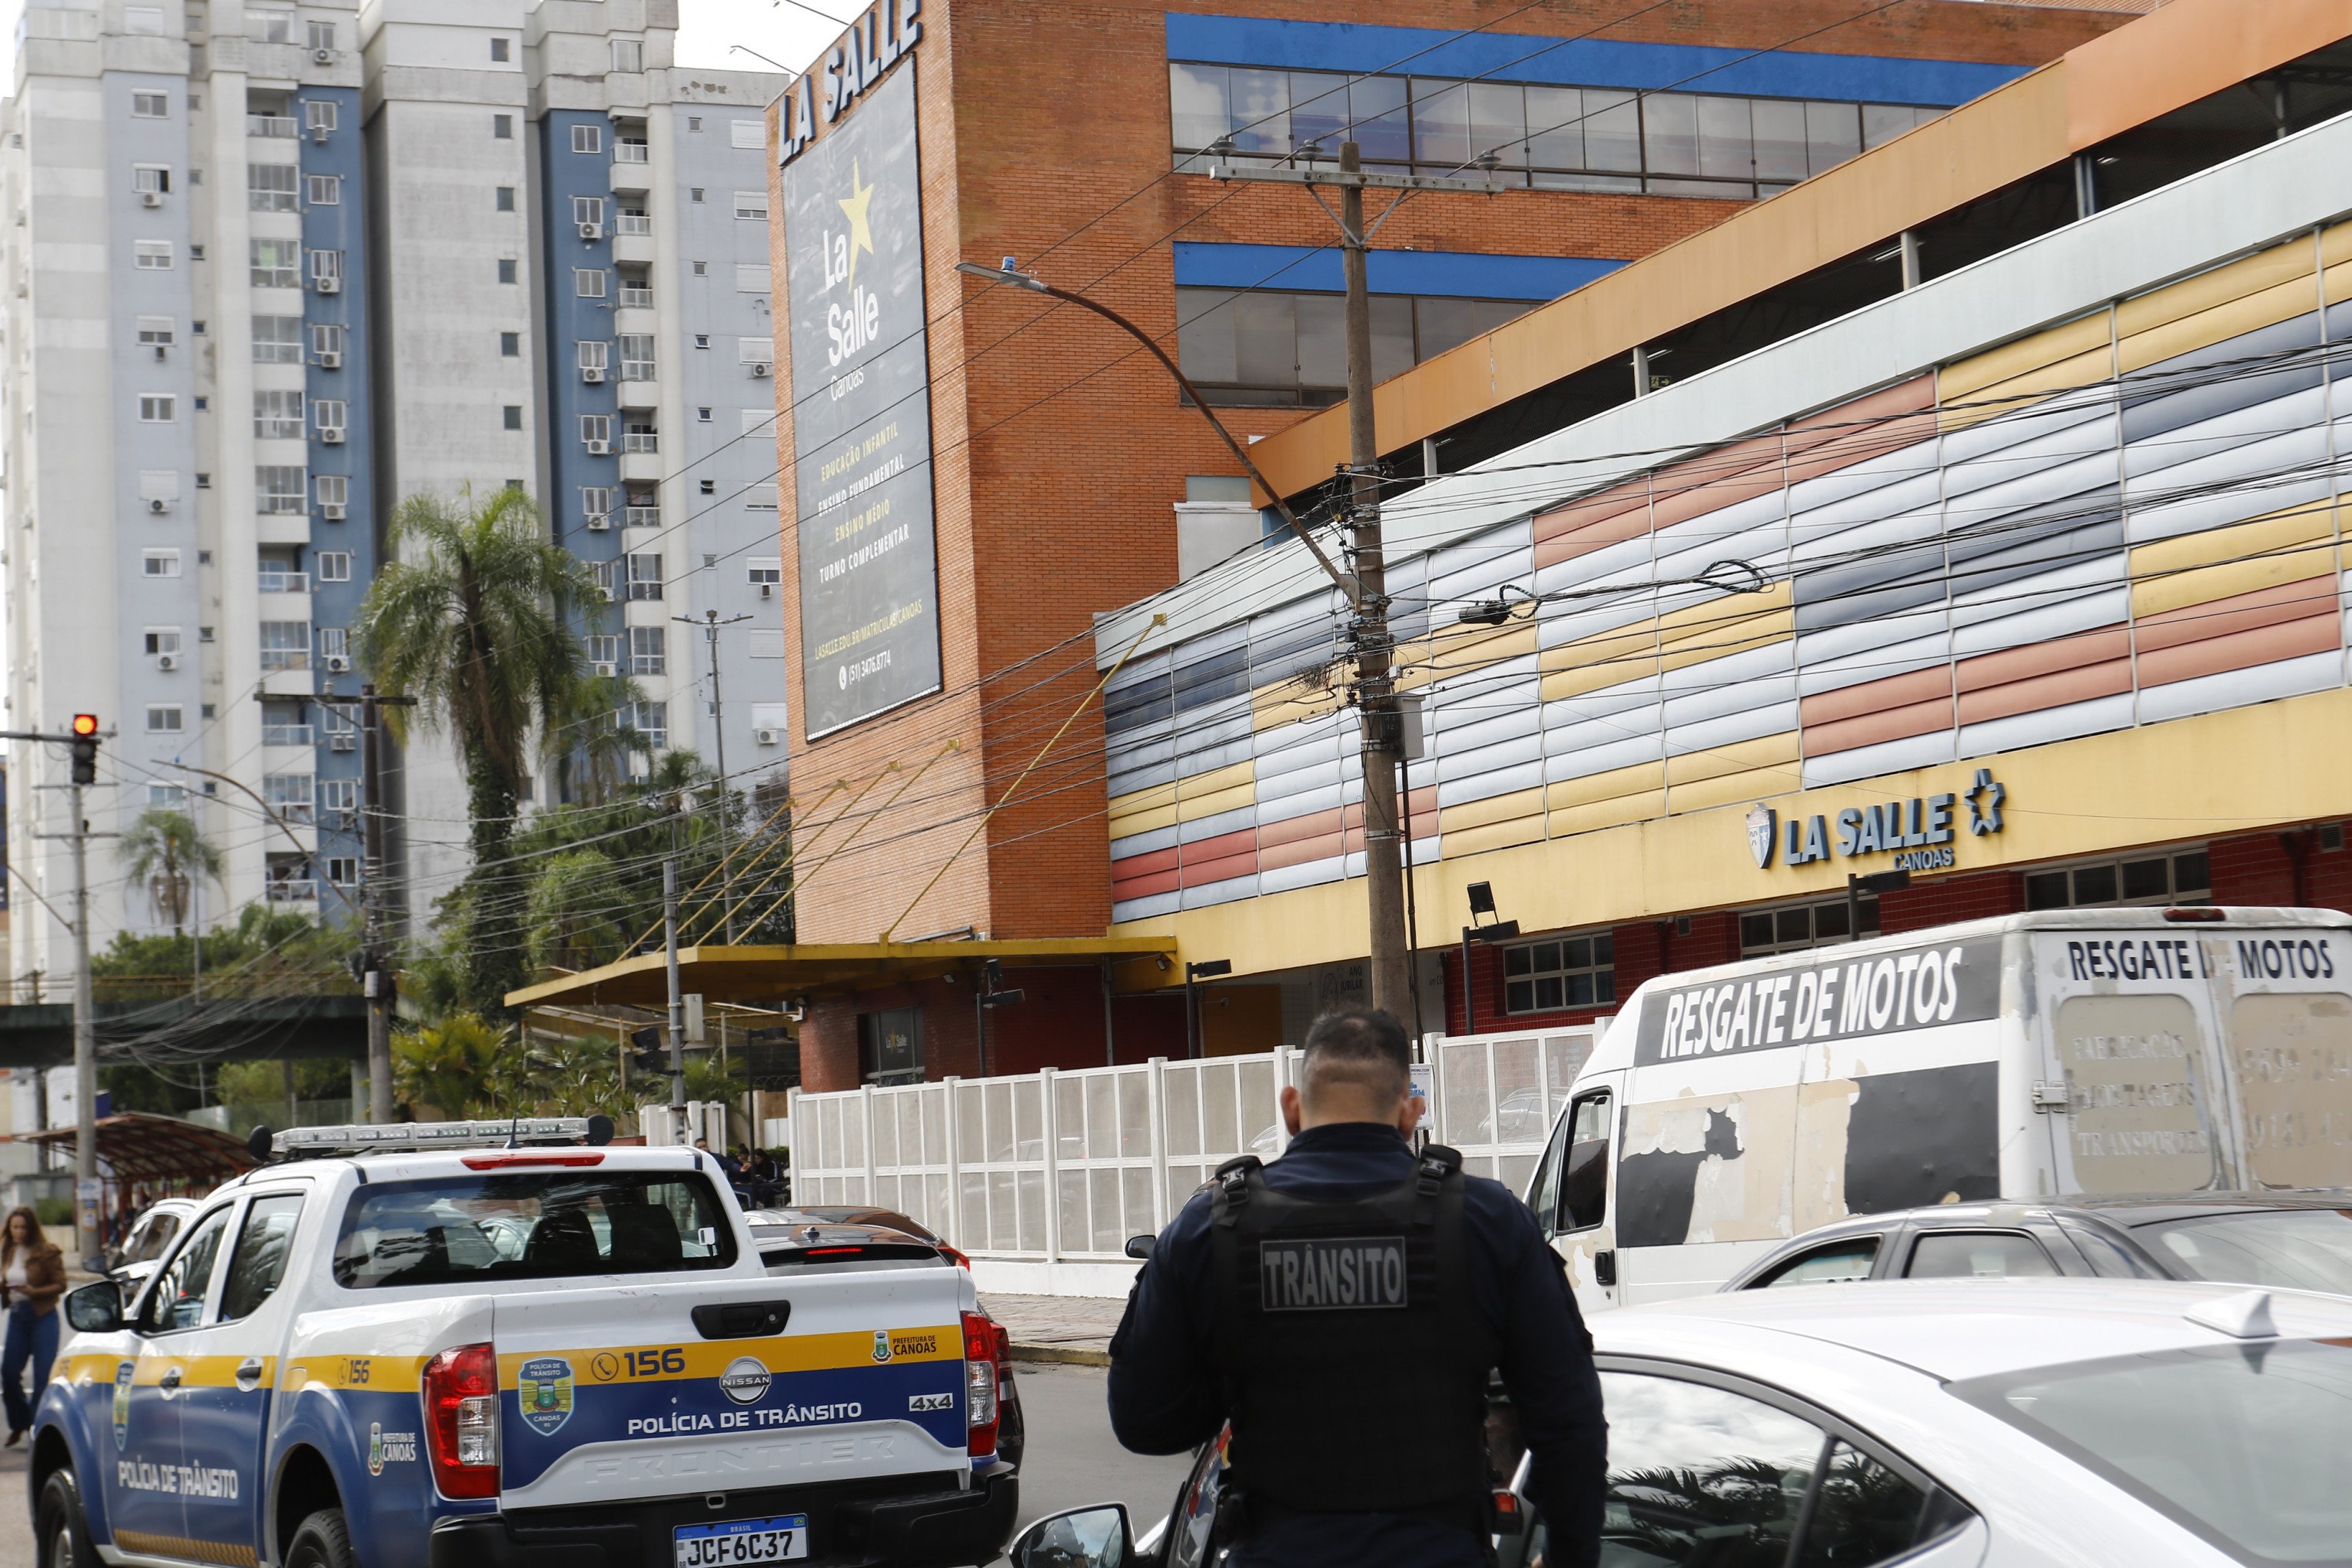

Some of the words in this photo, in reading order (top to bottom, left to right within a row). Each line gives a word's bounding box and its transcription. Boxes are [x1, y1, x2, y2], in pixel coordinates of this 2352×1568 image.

[779, 74, 816, 167] LA
[822, 0, 922, 124] SALLE
[823, 230, 848, 291] La
[827, 284, 879, 367] Salle
[830, 364, 864, 401] Canoas
[821, 445, 860, 482] EDUCAÇÃO
[862, 421, 898, 458] INFANTIL
[819, 489, 846, 517] ENSINO
[849, 453, 905, 500] FUNDAMENTAL
[835, 514, 863, 542] ENSINO
[866, 499, 889, 527] MÉDIO
[819, 558, 845, 584] TURNO
[849, 523, 909, 570] COMPLEMENTAR
[849, 663, 860, 685] (51)
[1783, 815, 1830, 866] LA
[1835, 792, 1955, 857] SALLE
[1894, 847, 1955, 872] CANOAS
[1349, 965, 1363, 977] ANO
[2067, 940, 2194, 981] RESGATE
[2237, 939, 2334, 980] MOTOS
[1340, 980, 1364, 994] JUBILAR
[1660, 974, 1792, 1058] RESGATE
[1791, 967, 1839, 1041] DE
[1839, 946, 1963, 1034] MOTOS
[1264, 1243, 1401, 1307] TRÂNSITO
[893, 1336, 927, 1344] PREFEITURA
[893, 1342, 936, 1355] CANOAS
[349, 1360, 370, 1384] 156
[623, 1348, 686, 1377] 156
[722, 1376, 770, 1386] NISSAN
[628, 1412, 715, 1435] POLÍCIA
[720, 1411, 750, 1429] DE
[755, 1402, 862, 1426] TRÂNSITO
[911, 1394, 952, 1410] 4x4
[382, 1443, 416, 1462] CANOAS
[584, 1435, 895, 1484] FRONTIER
[118, 1454, 160, 1492] POLÍCIA
[160, 1464, 177, 1493] DE
[177, 1459, 238, 1500] TRÂNSITO
[687, 1531, 793, 1566] JCF6C37
